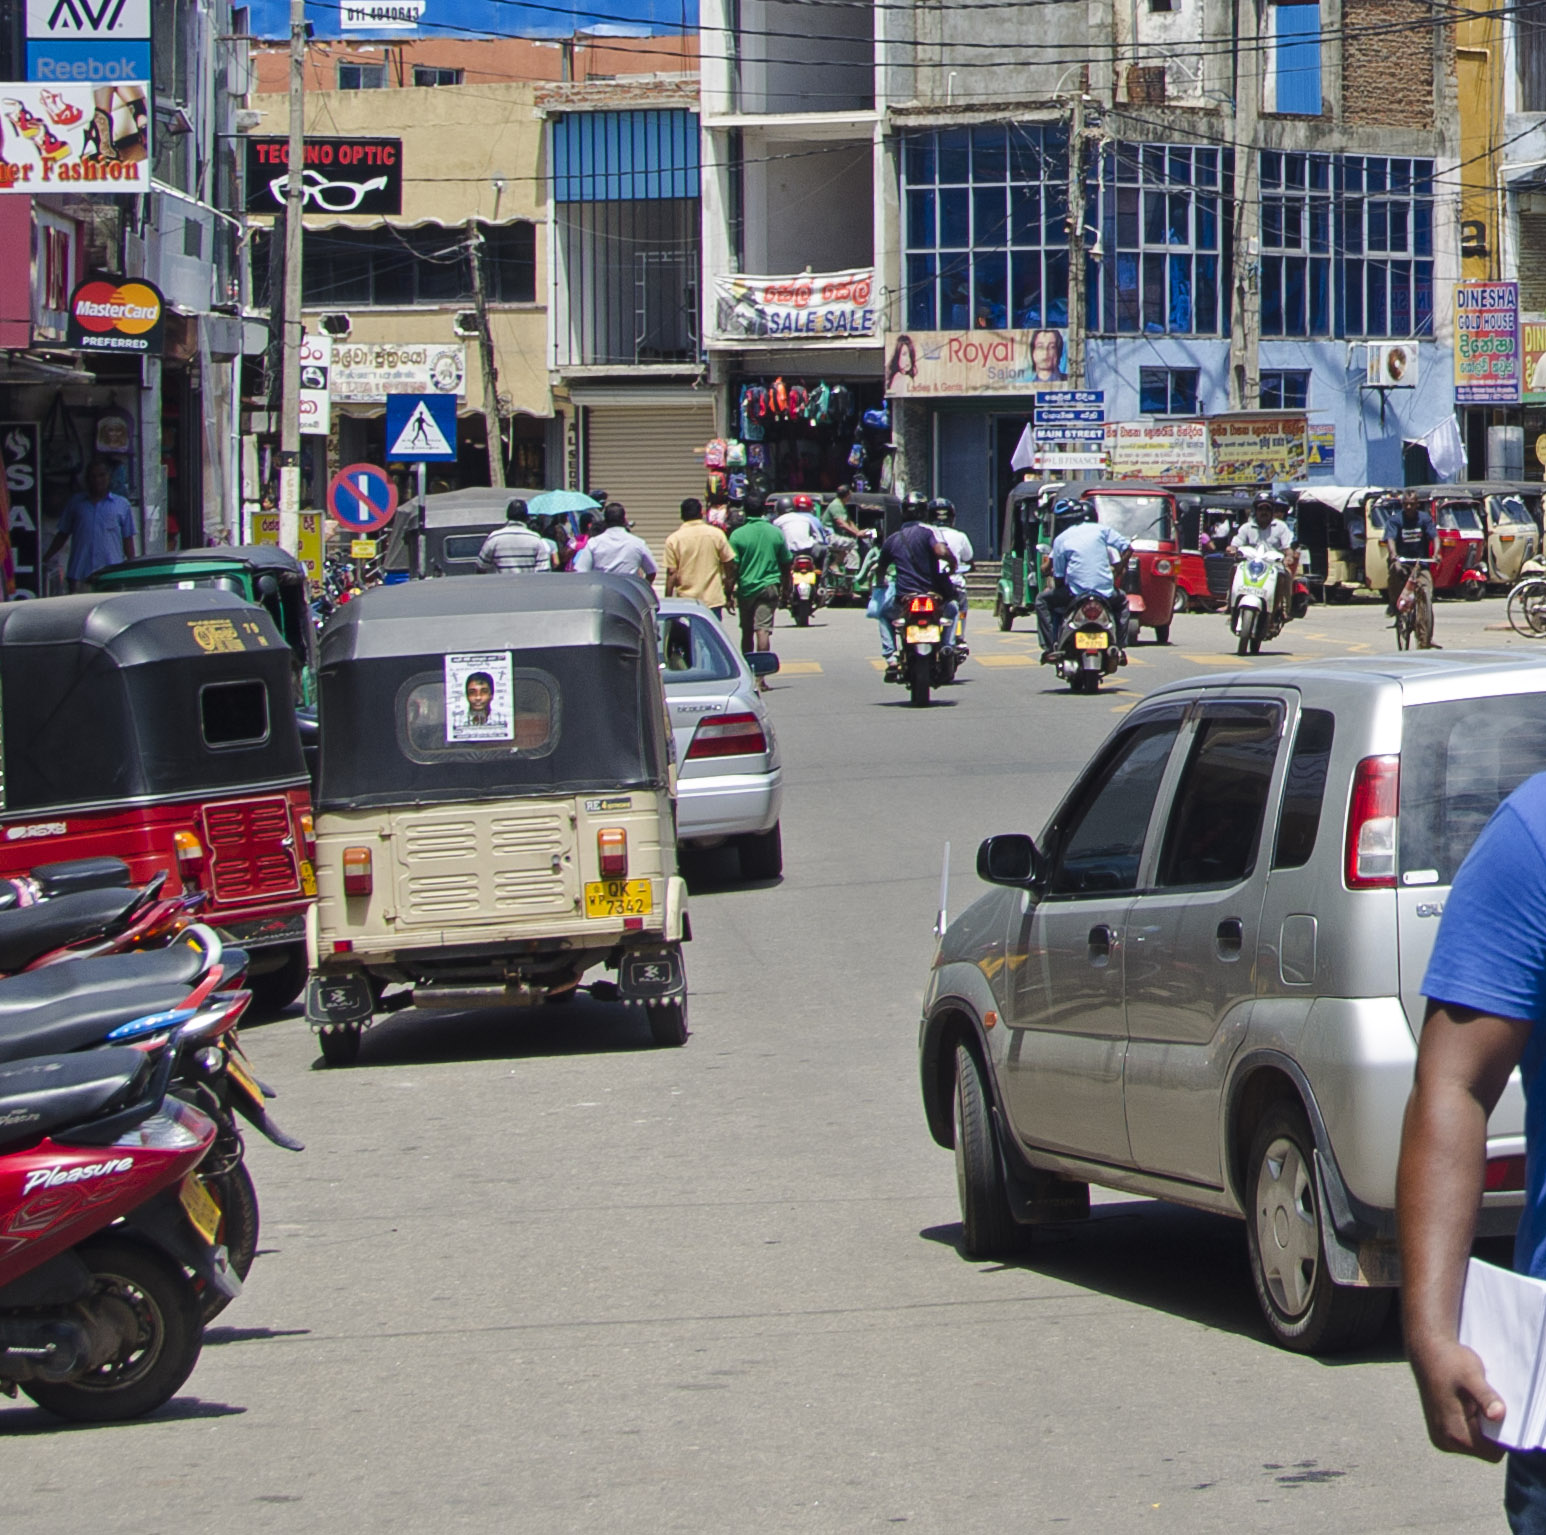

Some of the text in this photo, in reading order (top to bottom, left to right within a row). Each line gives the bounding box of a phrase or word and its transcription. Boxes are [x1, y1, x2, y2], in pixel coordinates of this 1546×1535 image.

[36, 57, 137, 80] Reebok
[338, 145, 396, 165] OPTIC
[41, 155, 140, 182] Fashion
[1457, 287, 1516, 310] DINESHA
[75, 299, 158, 320] MasterCard
[769, 309, 874, 334] SALE SALE
[1458, 313, 1514, 330] GOLD HOUSE
[82, 336, 148, 349] PREFERRED
[949, 336, 1014, 368] Royal
[988, 366, 1027, 381] Salon
[1037, 428, 1103, 439] MAIN STREET
[608, 882, 630, 898] QK
[606, 898, 644, 915] 7342
[22, 1156, 134, 1196] Pleasure
